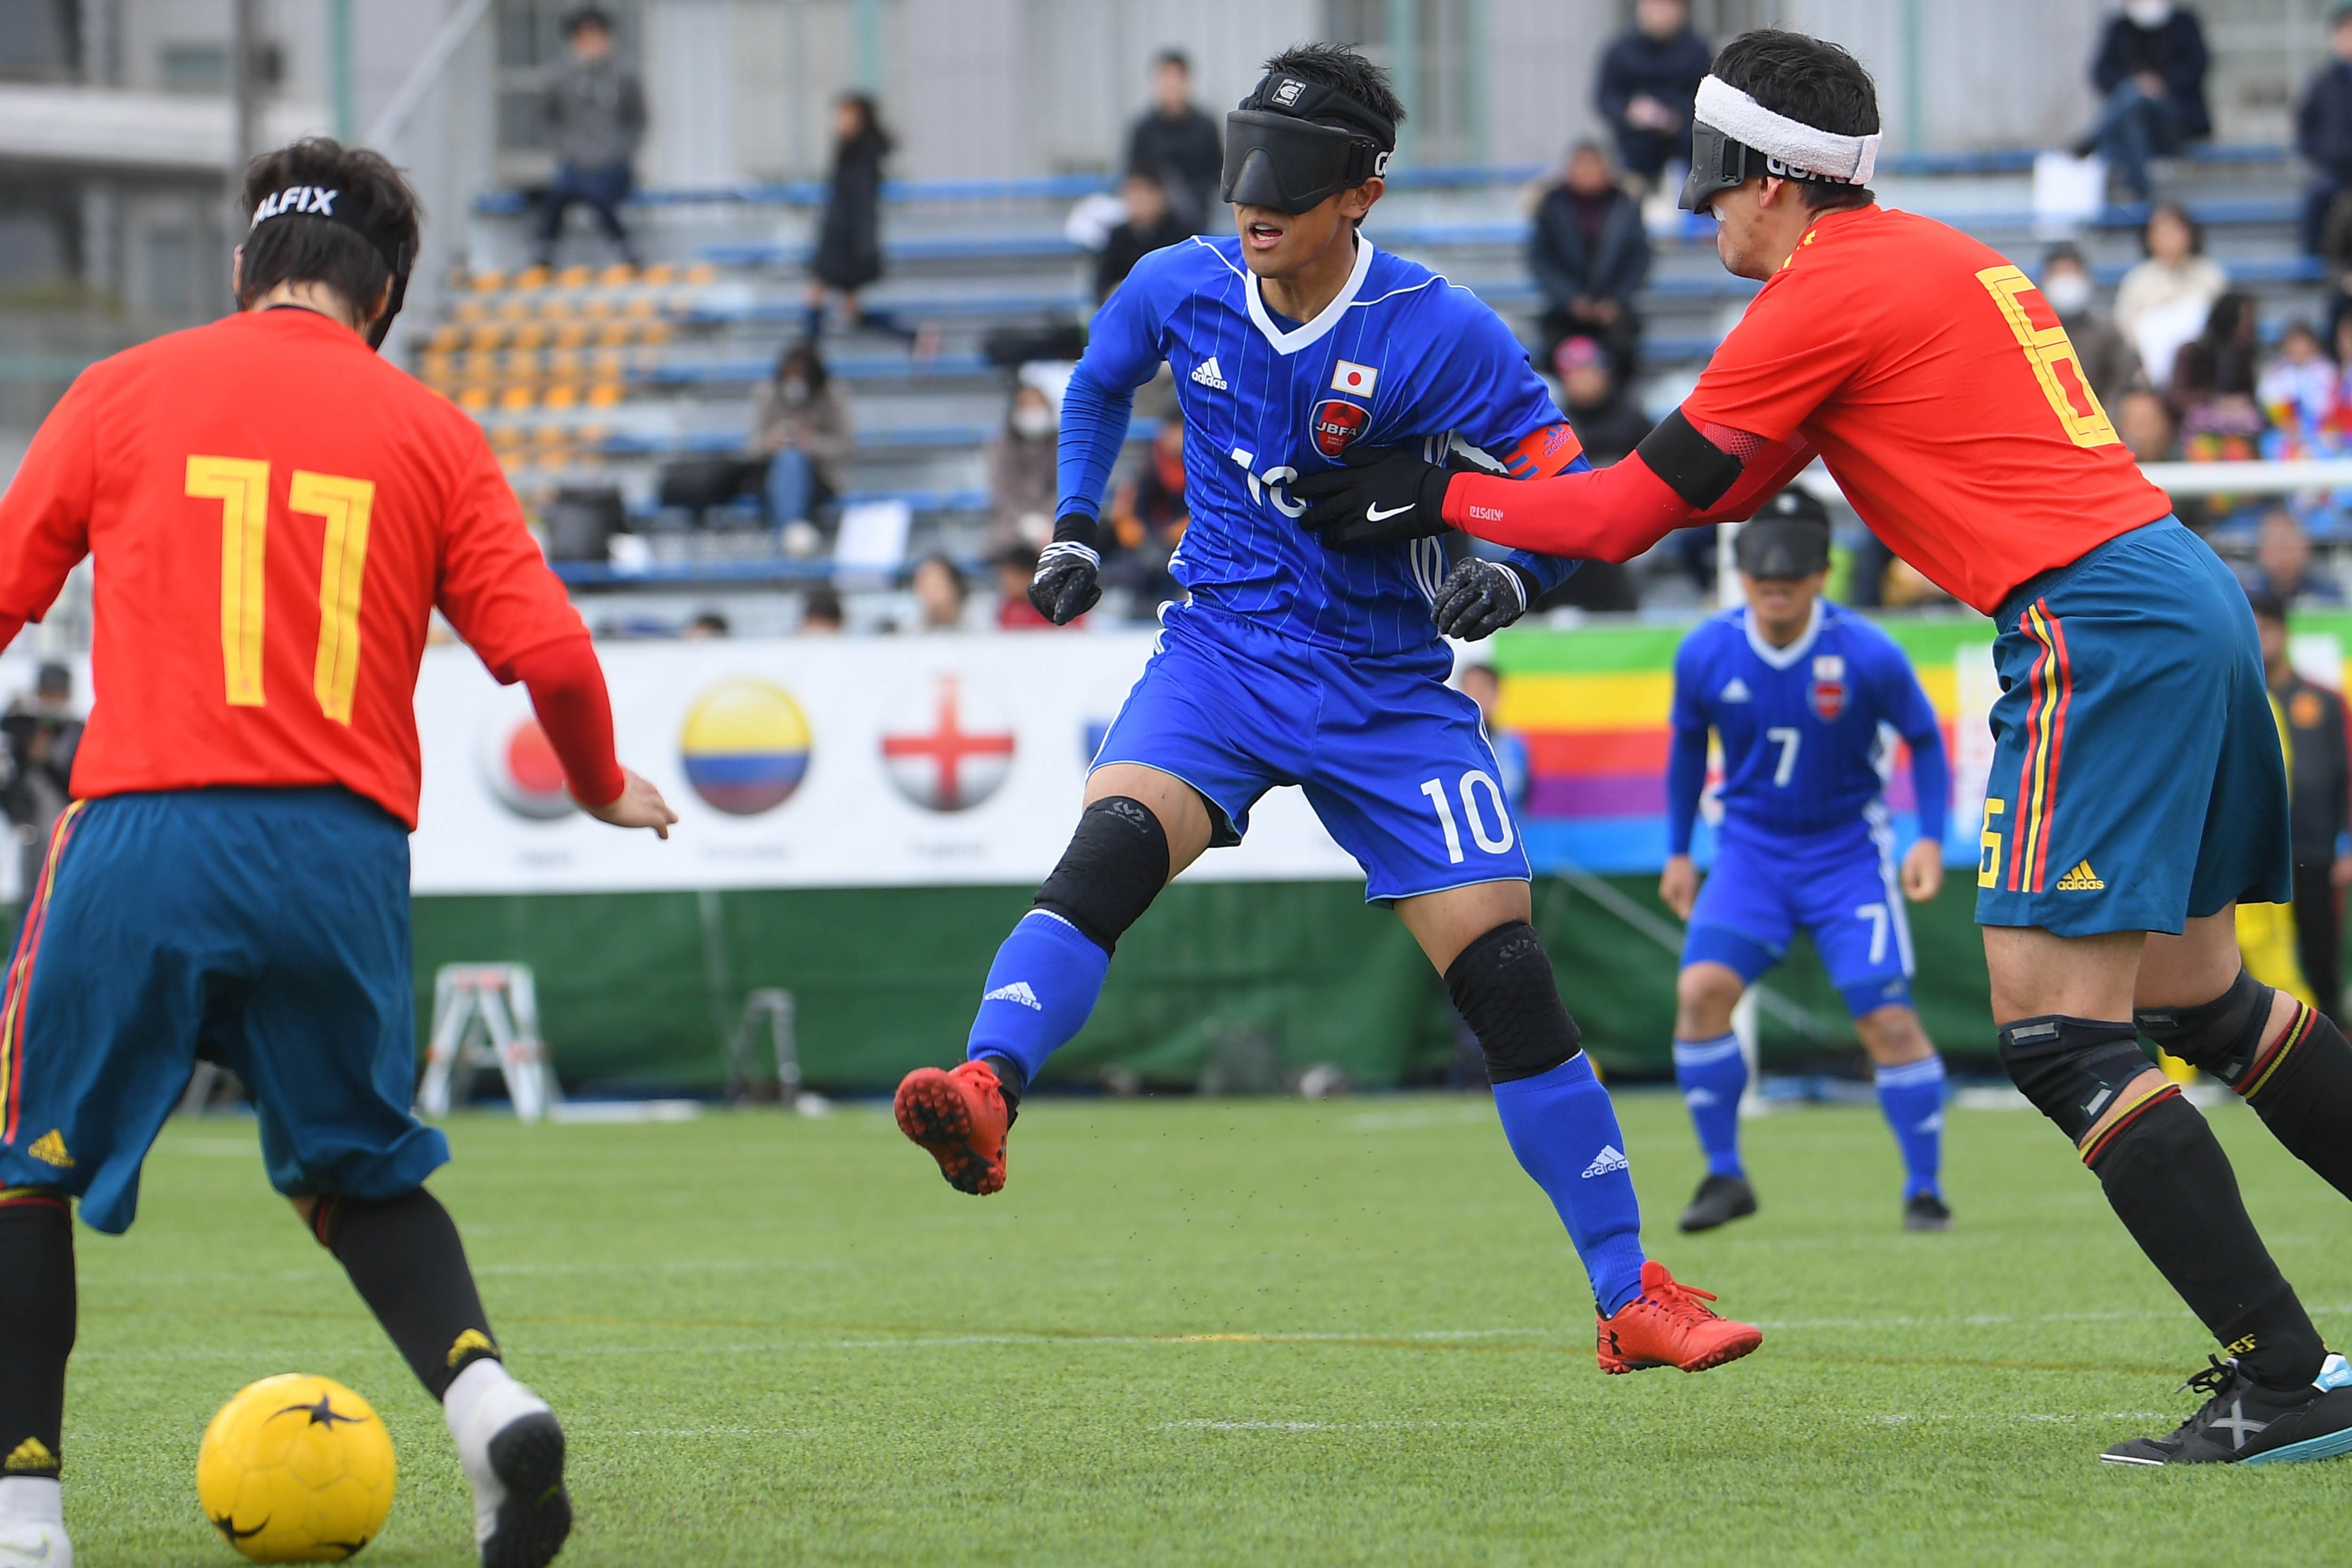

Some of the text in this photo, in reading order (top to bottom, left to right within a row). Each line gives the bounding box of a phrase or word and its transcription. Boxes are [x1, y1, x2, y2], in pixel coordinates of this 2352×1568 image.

[1192, 371, 1228, 390] adidas
[1975, 264, 2121, 448] 6
[1316, 422, 1357, 436] JBFA
[1544, 430, 1572, 457] adidas
[184, 454, 375, 726] 11
[1767, 727, 1800, 788] 7
[1420, 770, 1514, 864] 10
[1977, 798, 2004, 889] 6
[2057, 879, 2104, 890] adidas
[1855, 902, 1888, 965] 7
